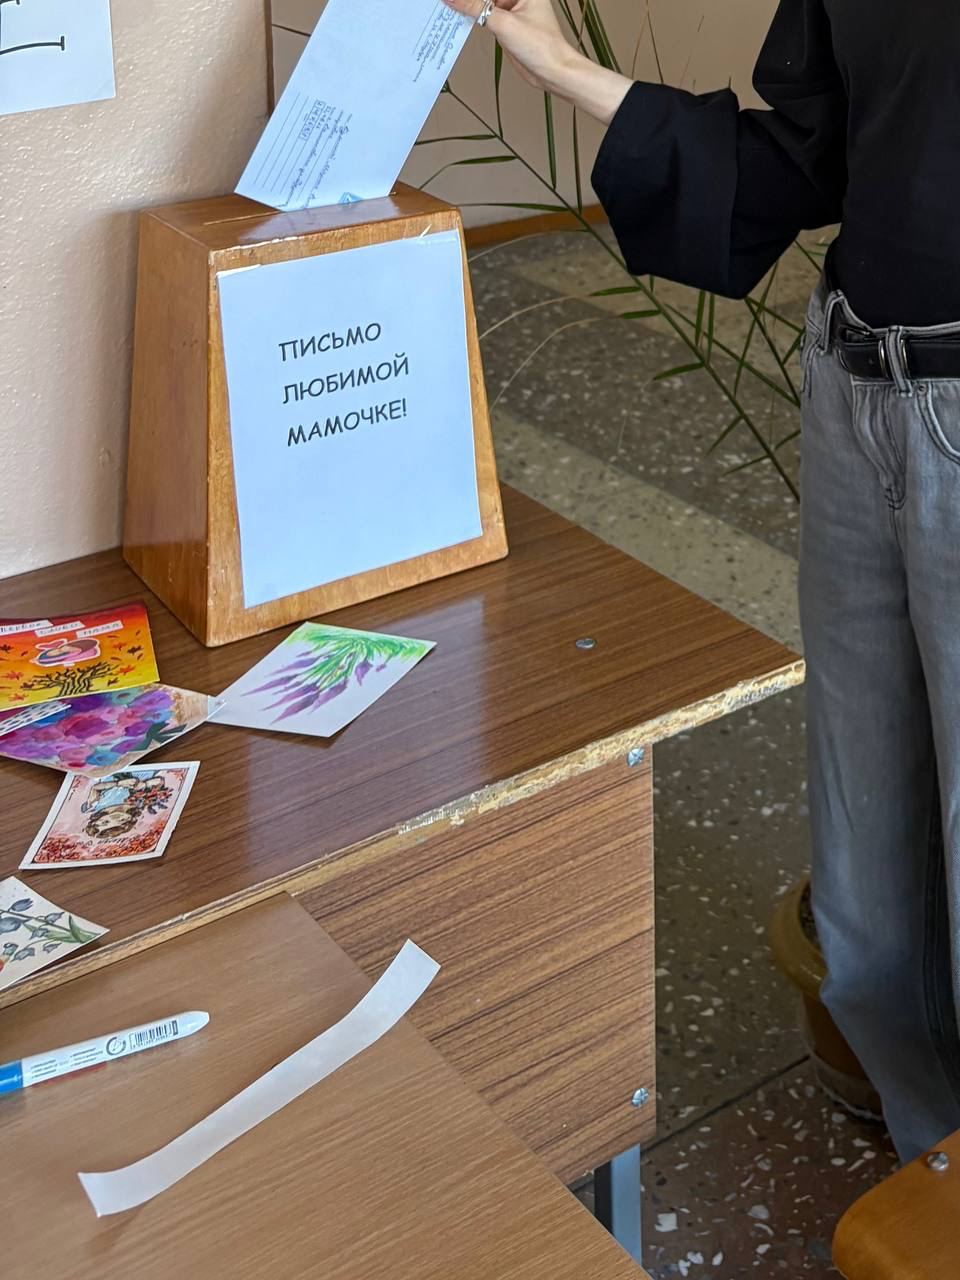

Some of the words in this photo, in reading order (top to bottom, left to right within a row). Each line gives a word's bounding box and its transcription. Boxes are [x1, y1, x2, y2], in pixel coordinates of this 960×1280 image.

[278, 322, 382, 362] ПИСЬМО
[282, 351, 409, 405] ЛЮБИМОЙ
[287, 397, 408, 447] МАМОЧКЕ!
